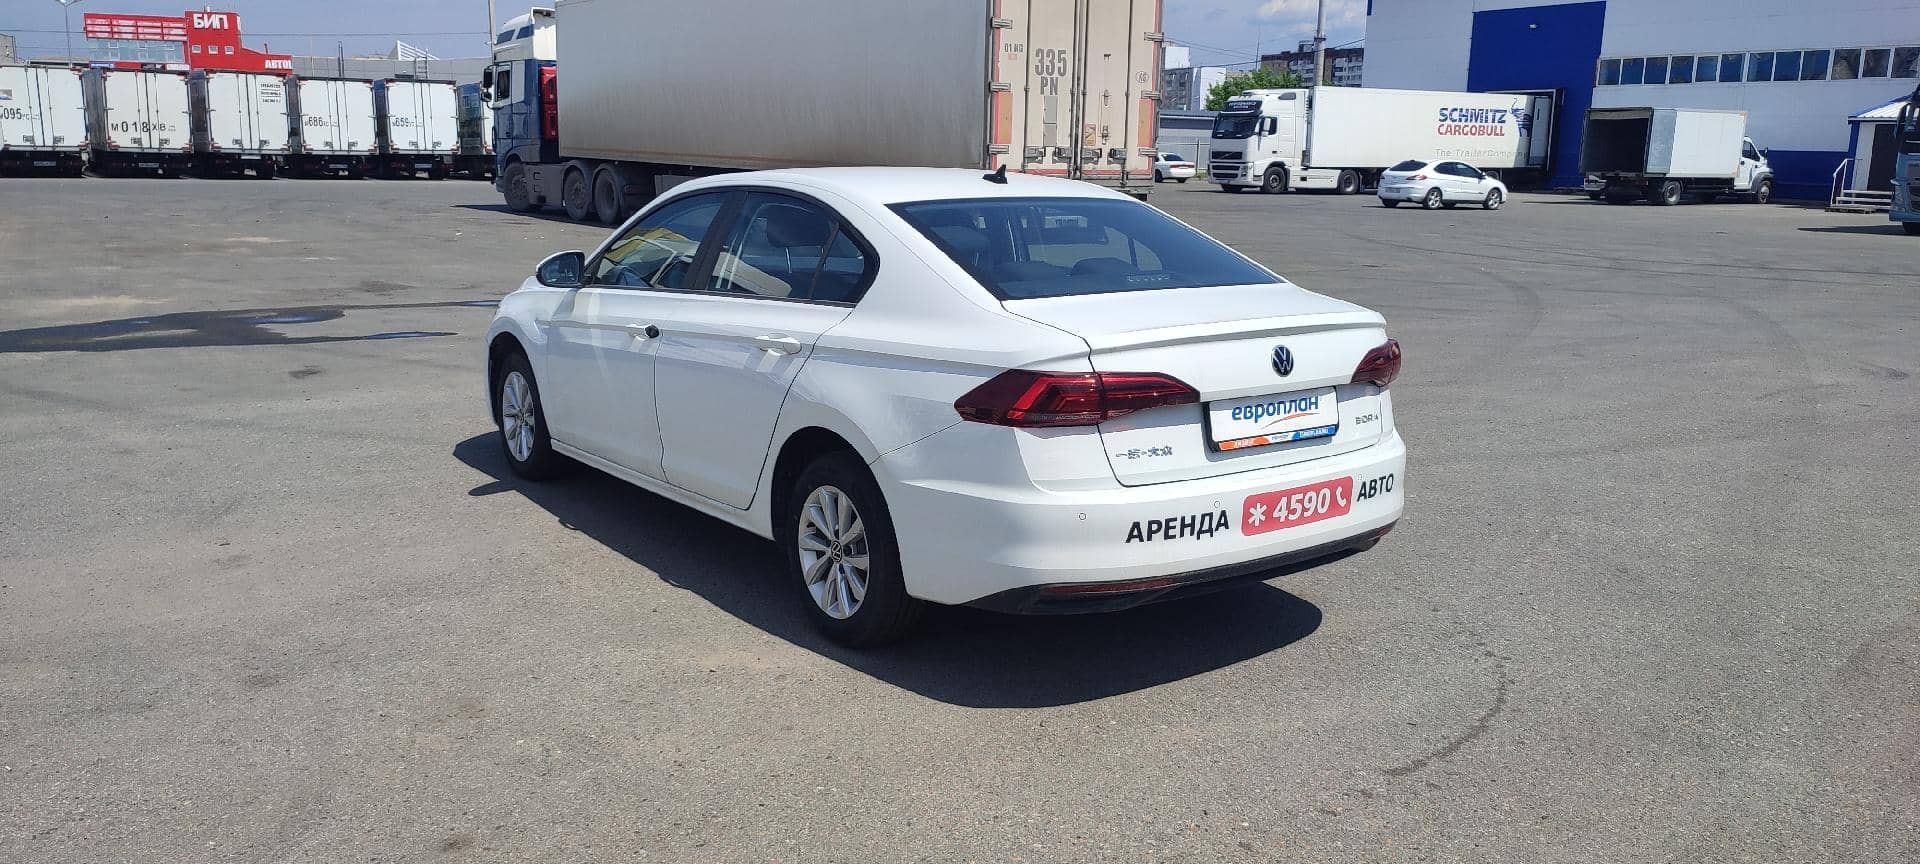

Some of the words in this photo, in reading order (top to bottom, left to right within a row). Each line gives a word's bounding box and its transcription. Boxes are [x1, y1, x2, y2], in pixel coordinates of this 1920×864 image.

[193, 13, 229, 30] БИП
[1034, 48, 1067, 77] 335
[1040, 76, 1058, 96] PN
[1438, 107, 1508, 124] SCHMITZ
[1437, 123, 1505, 137] CARGOBULL
[1435, 148, 1452, 157] The
[1231, 395, 1319, 424] европлан
[1125, 509, 1230, 543] АРЕНДА
[1356, 472, 1395, 502] АВТО
